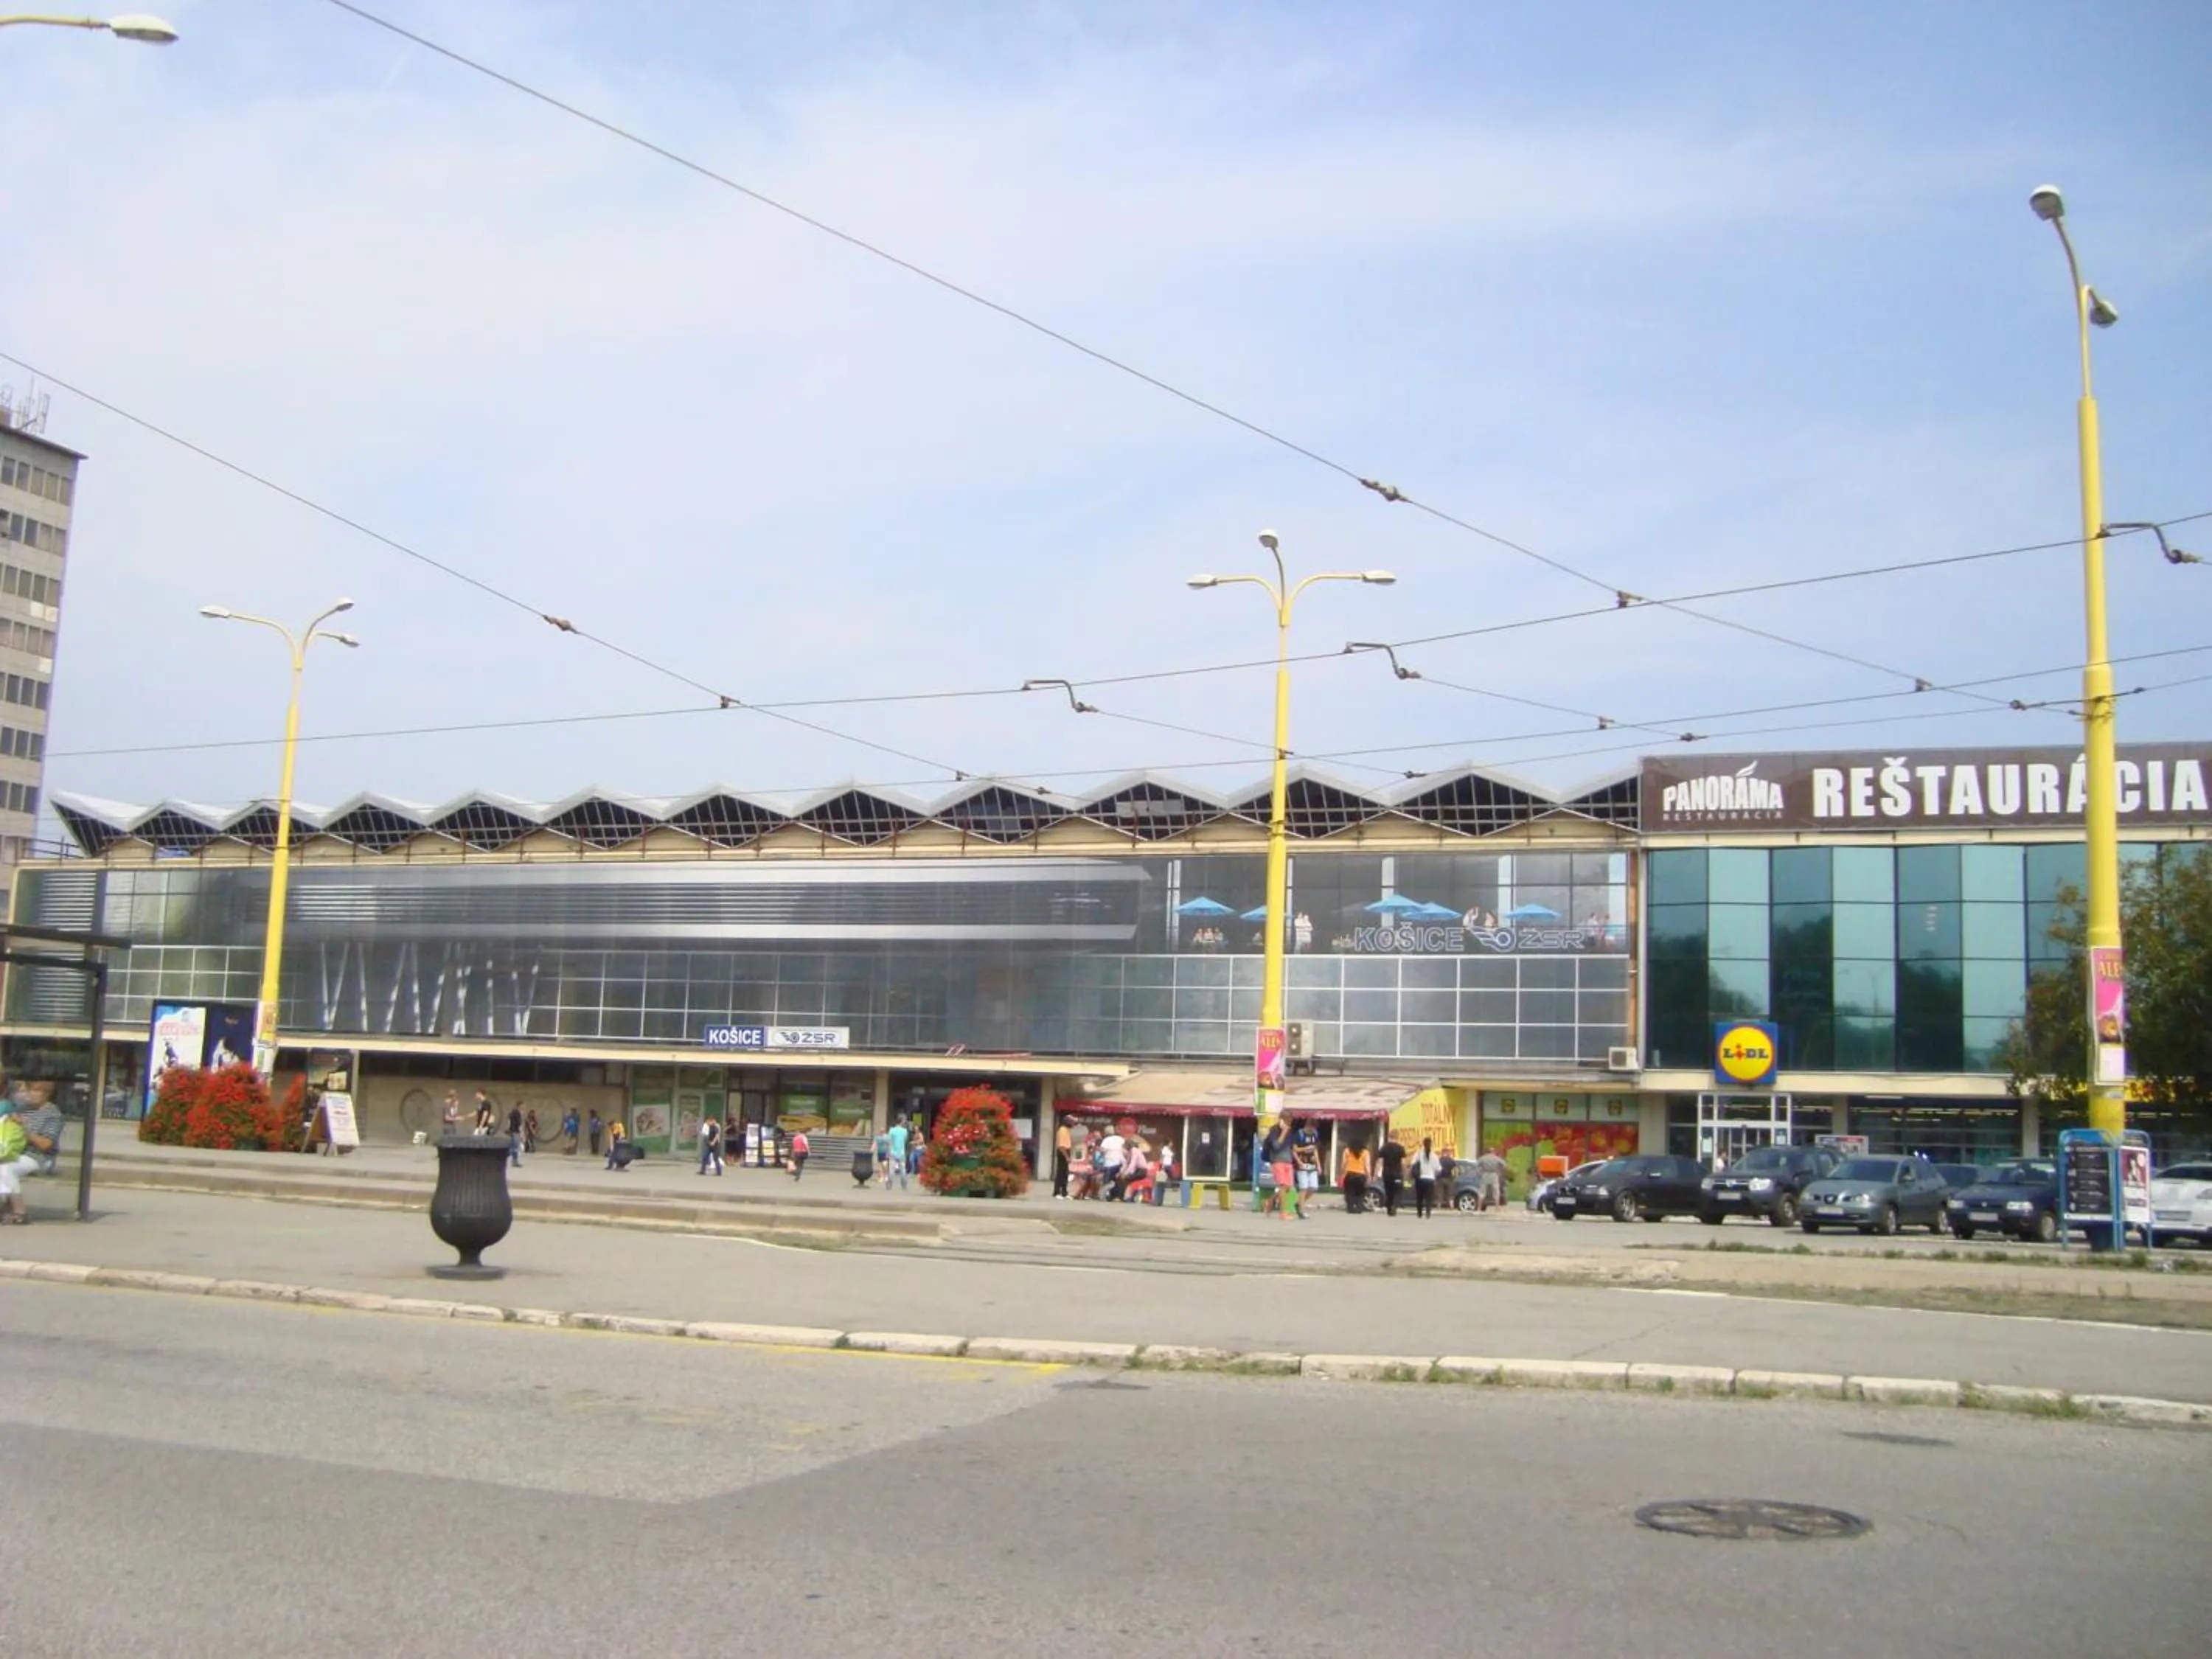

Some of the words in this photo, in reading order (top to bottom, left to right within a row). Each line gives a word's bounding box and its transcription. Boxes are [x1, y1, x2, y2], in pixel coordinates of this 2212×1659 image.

[1812, 754, 2209, 818] REŠTAURÁCIA
[1354, 922, 1464, 952] KOŠICE
[709, 1028, 762, 1045] KOŠICE
